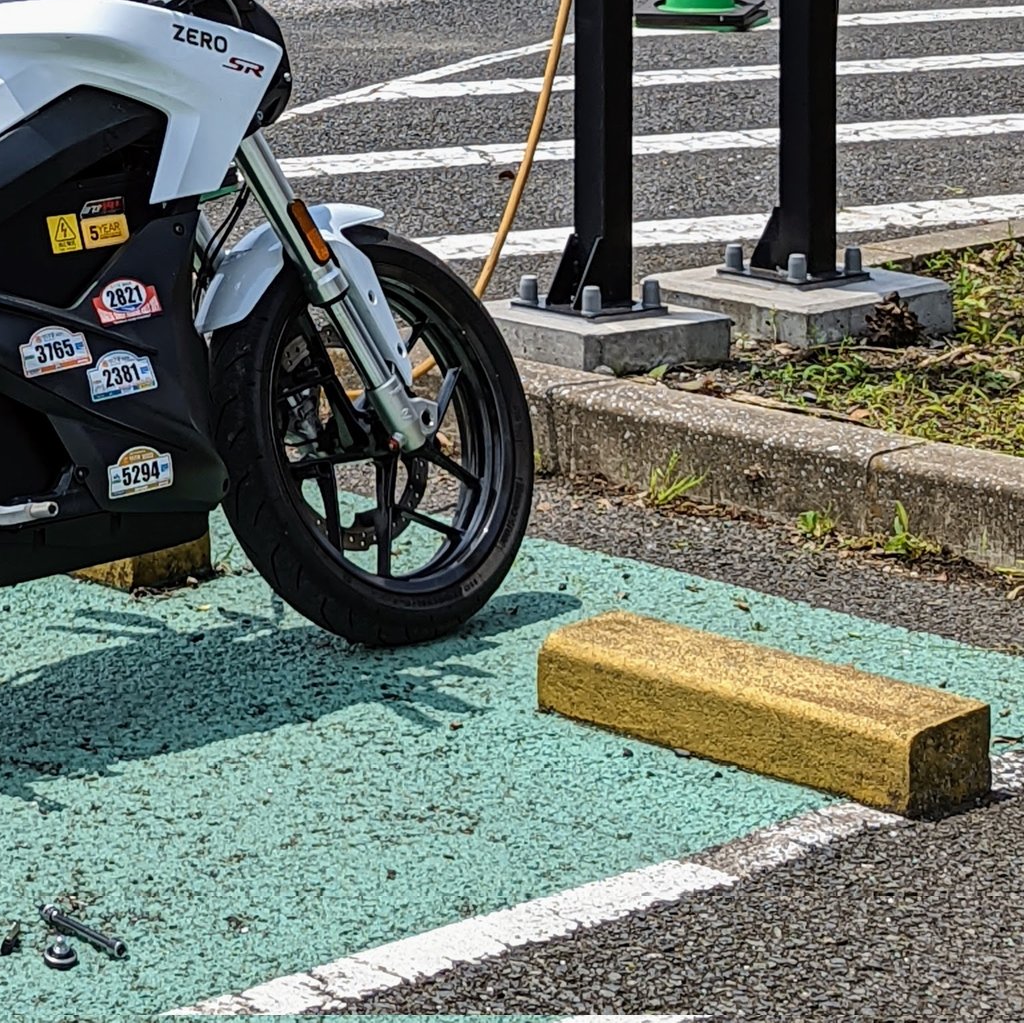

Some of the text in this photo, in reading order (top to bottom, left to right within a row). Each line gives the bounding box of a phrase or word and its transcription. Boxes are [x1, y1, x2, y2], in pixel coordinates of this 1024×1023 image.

[172, 23, 228, 53] ZERO
[222, 57, 265, 78] SR
[106, 285, 143, 307] 2821
[35, 338, 75, 363] 3765
[102, 362, 140, 388] 2381
[122, 460, 160, 486] 5294
